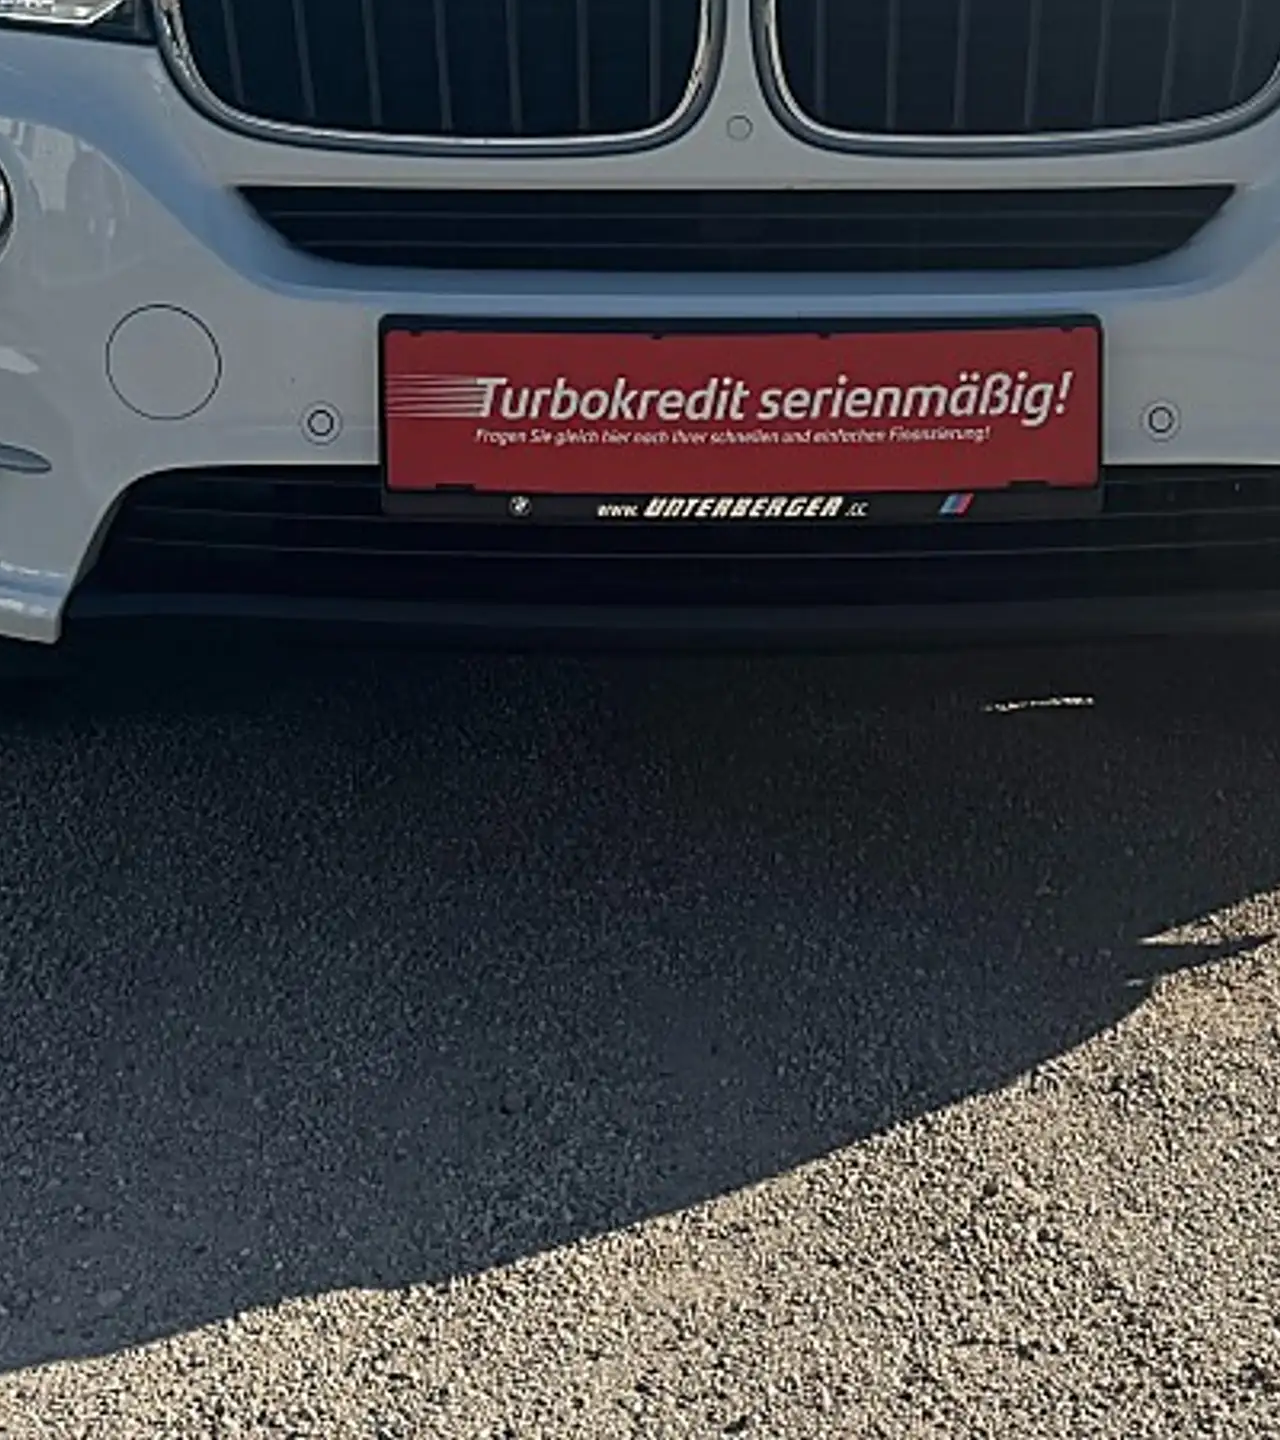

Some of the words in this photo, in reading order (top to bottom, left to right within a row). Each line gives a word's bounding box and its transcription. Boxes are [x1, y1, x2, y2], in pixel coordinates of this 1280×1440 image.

[475, 376, 751, 421] Turbokredit
[756, 369, 1074, 427] serienmäßig!
[476, 428, 527, 446] Fragen
[529, 428, 552, 443] Sie
[554, 428, 599, 446] gleich
[601, 429, 632, 444] hier
[710, 428, 780, 444] schnellen
[781, 428, 812, 443] und
[888, 425, 991, 443] Finanzierung!
[642, 495, 844, 518] UNTERBERGER
